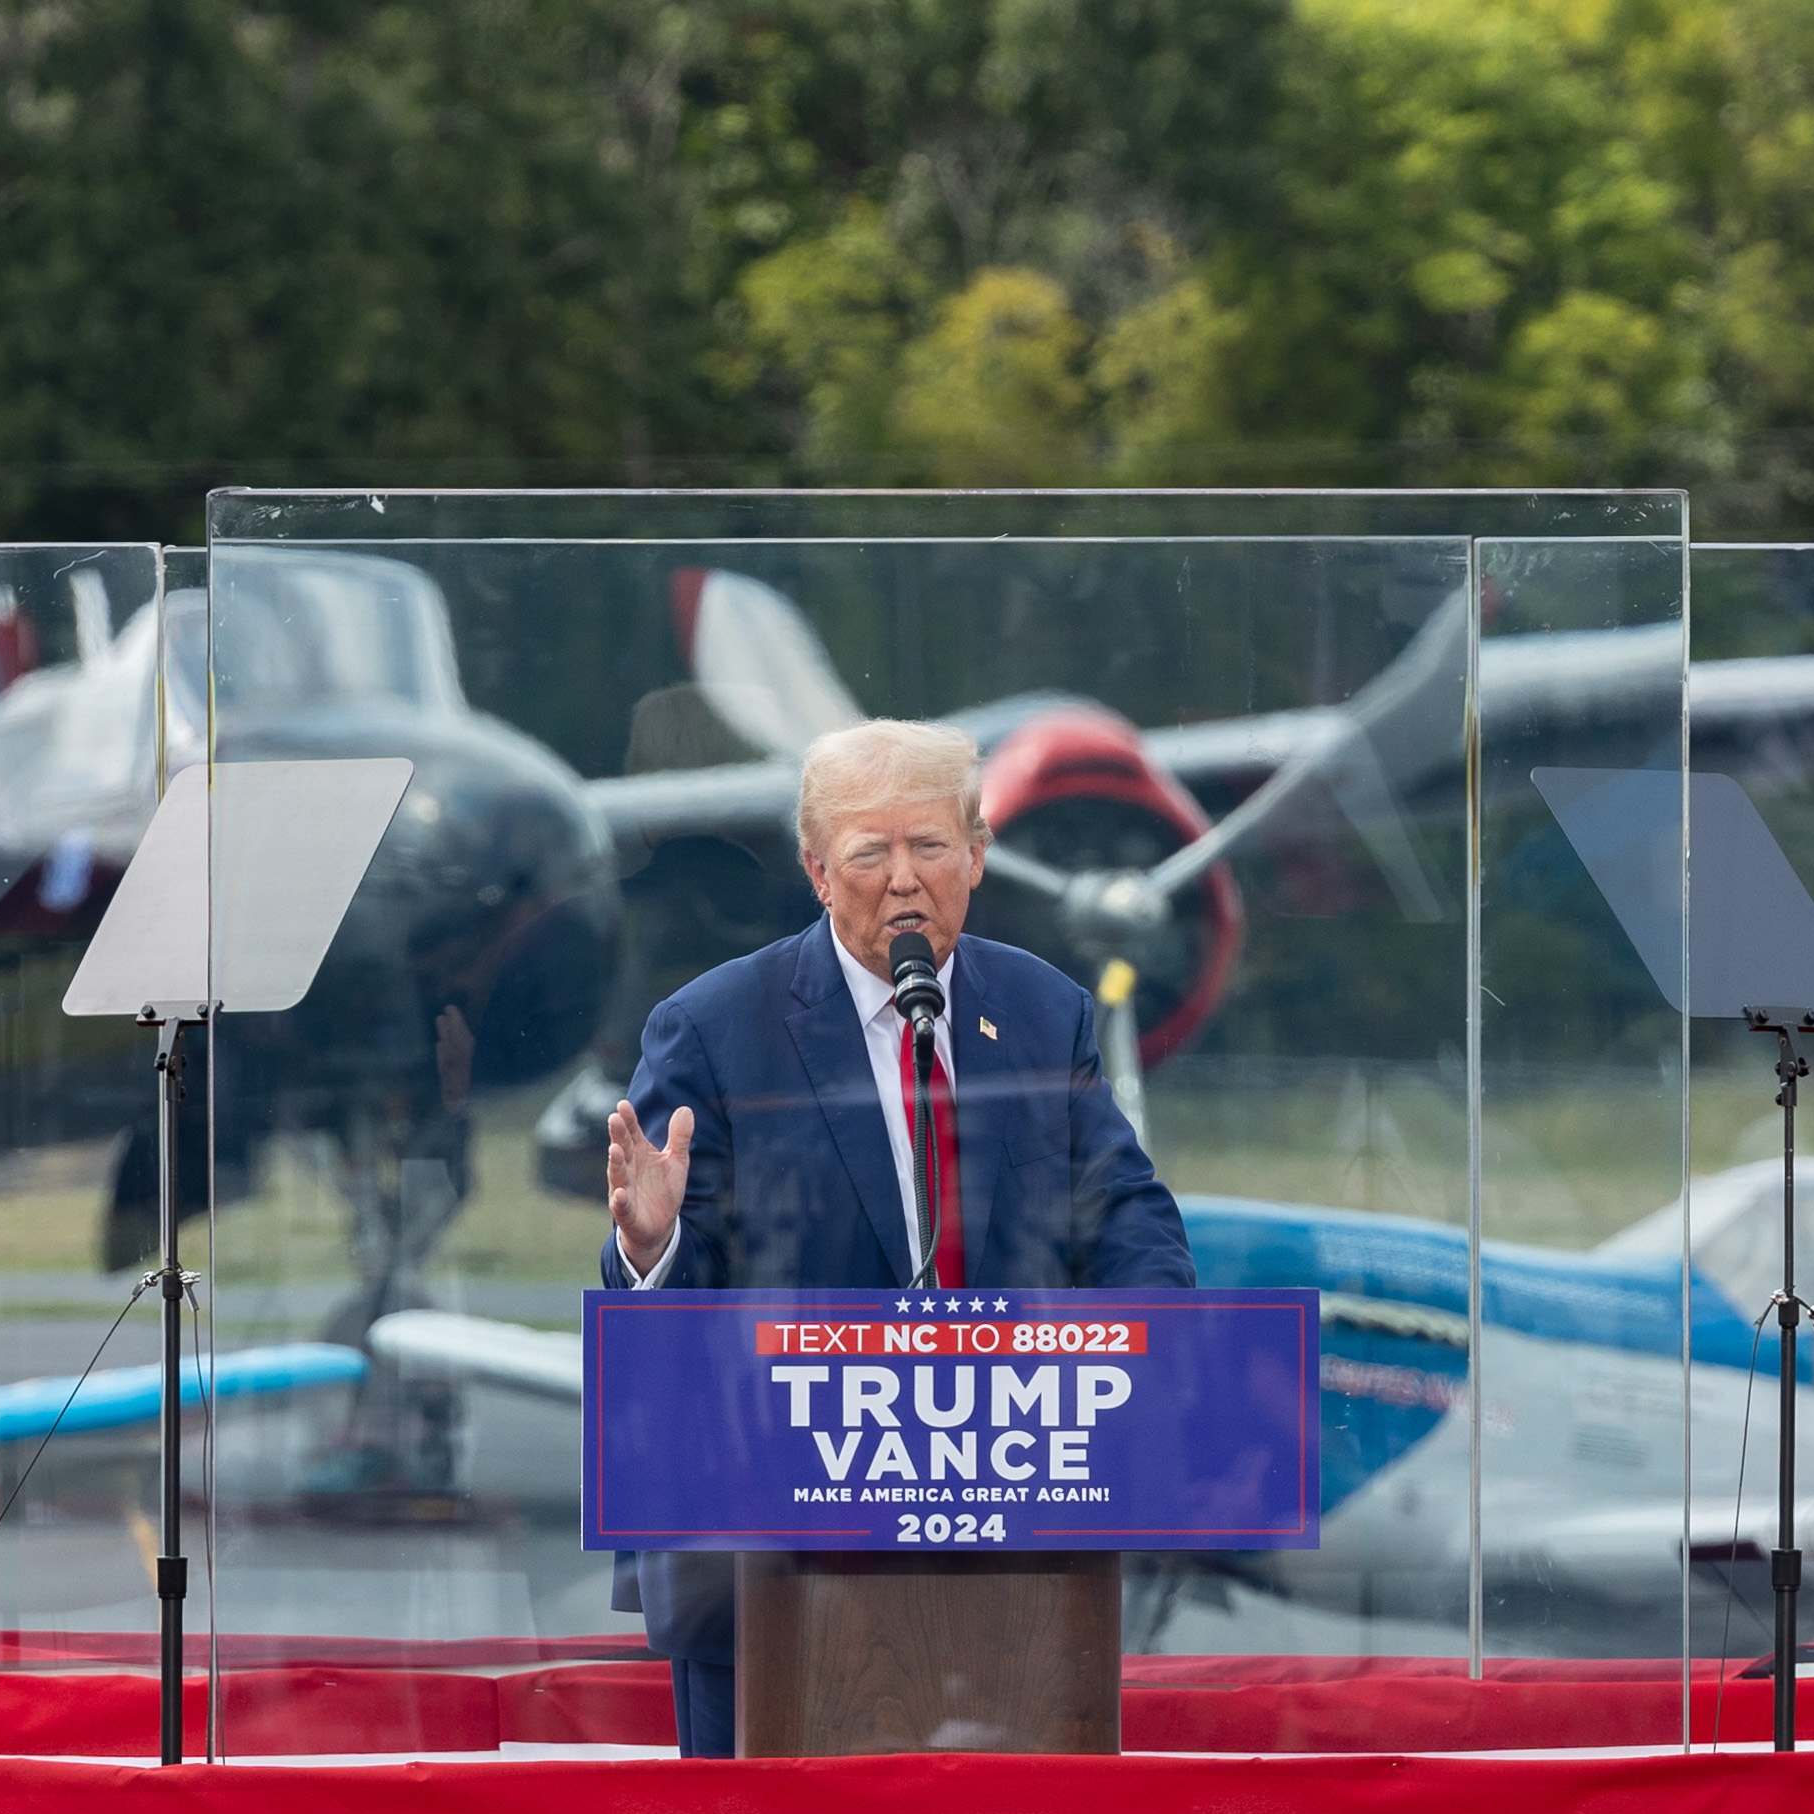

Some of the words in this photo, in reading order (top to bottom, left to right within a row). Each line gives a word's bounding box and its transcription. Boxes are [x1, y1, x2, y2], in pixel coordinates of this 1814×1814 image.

[775, 1324, 870, 1353] TEXT
[883, 1324, 938, 1353] NC
[949, 1323, 1000, 1353] TO
[1012, 1323, 1130, 1353] 88022
[772, 1366, 1133, 1428] TRUMP
[813, 1431, 1090, 1481] VANCE
[794, 1487, 852, 1503] MAKE
[860, 1487, 955, 1503] AMERICA
[961, 1487, 1030, 1503] GREAT
[1036, 1487, 1110, 1503] AGAIN!
[897, 1513, 1007, 1543] 2024
